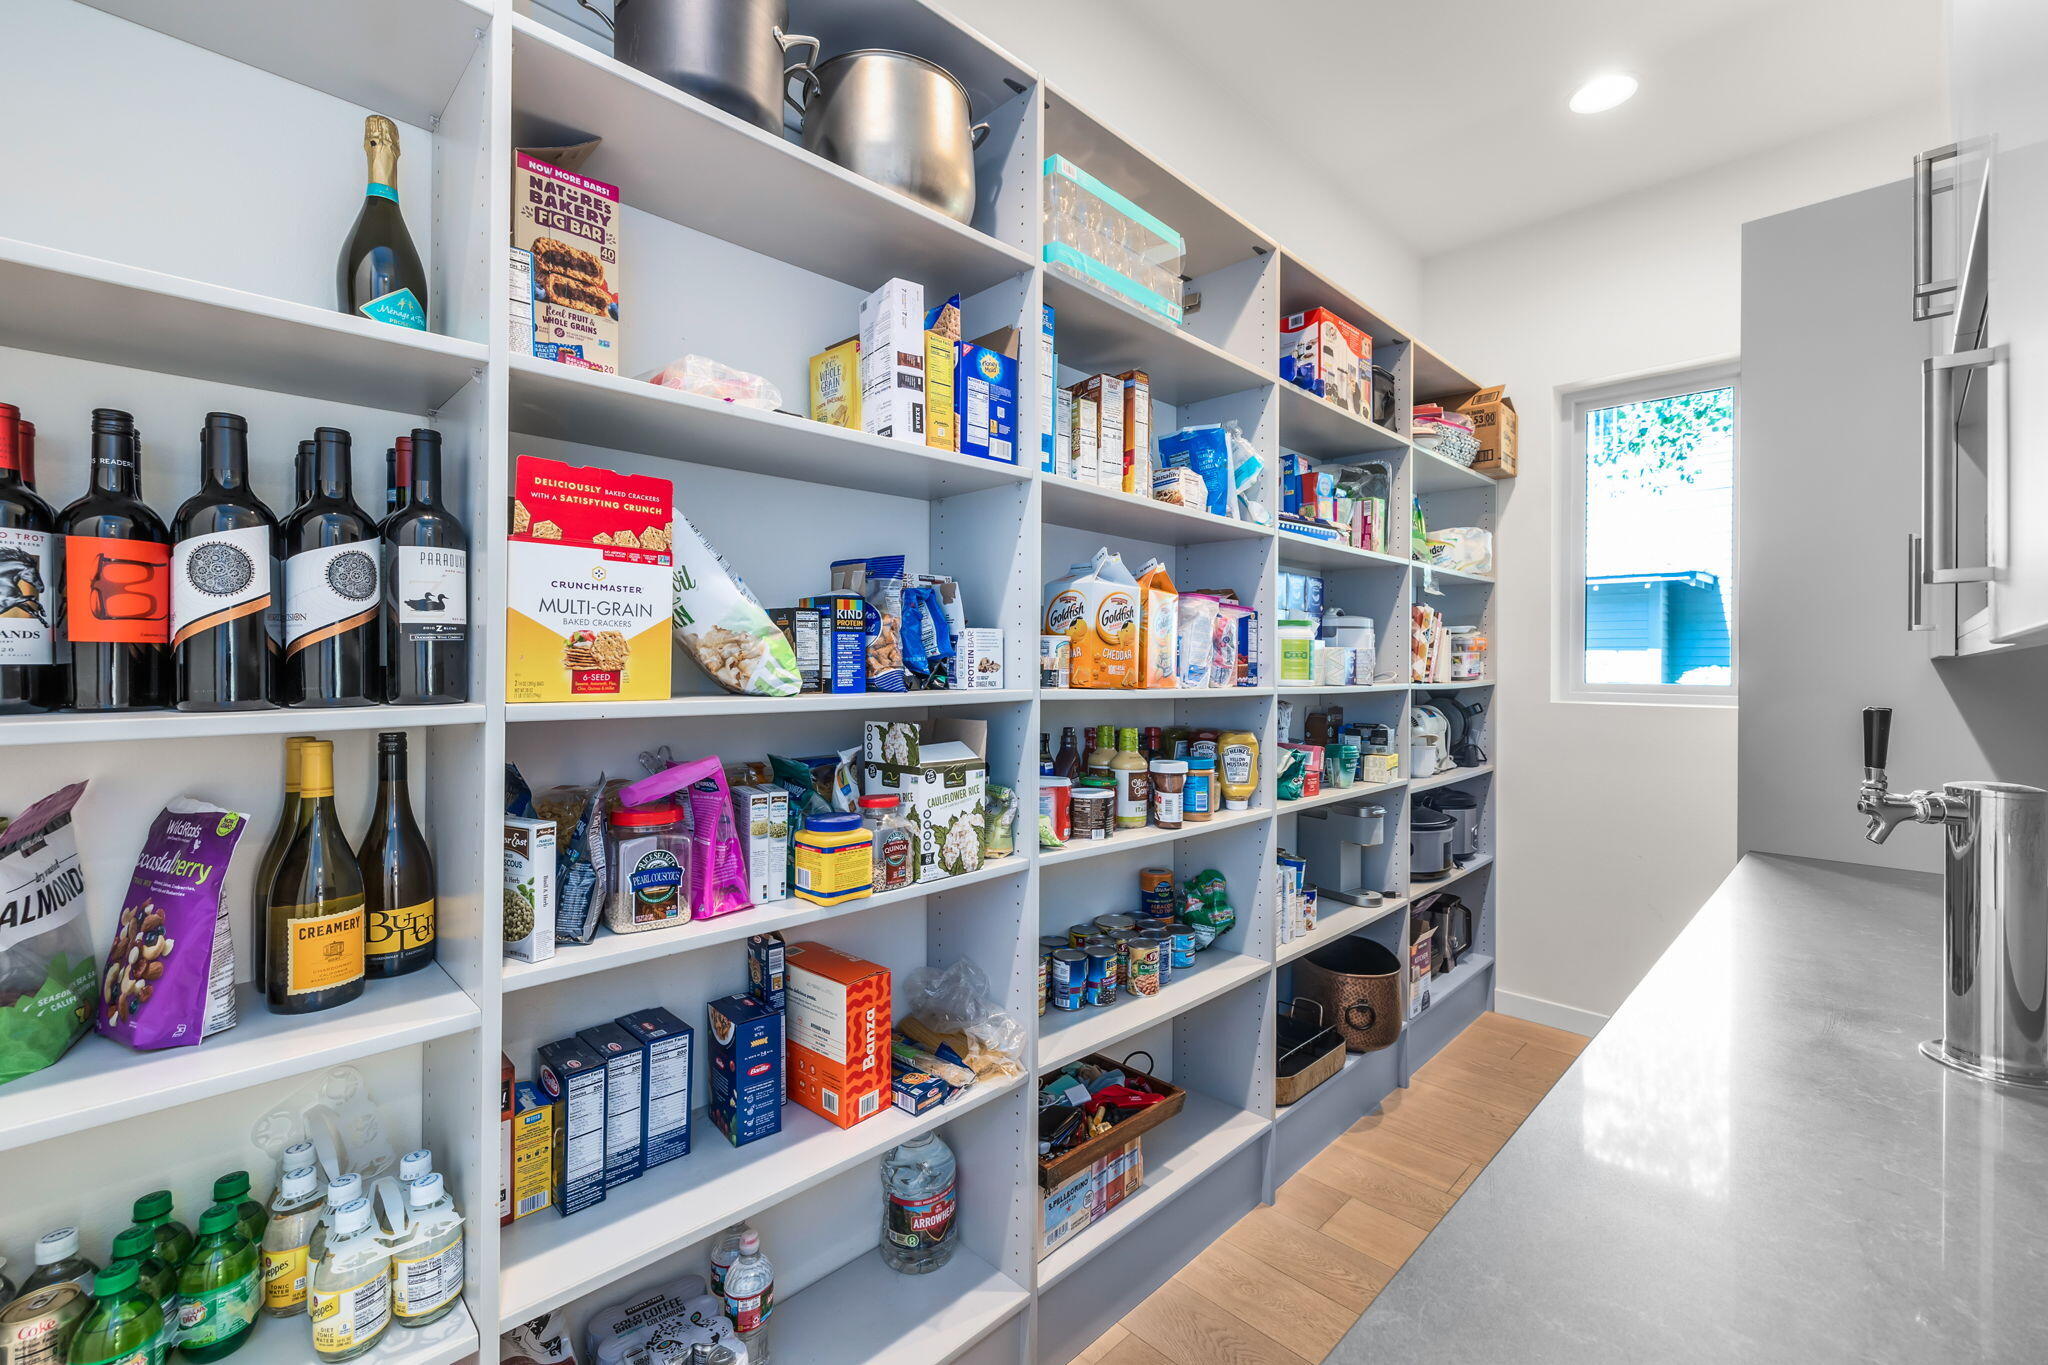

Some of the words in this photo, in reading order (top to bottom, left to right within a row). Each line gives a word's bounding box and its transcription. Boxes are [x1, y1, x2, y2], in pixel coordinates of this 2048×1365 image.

[529, 161, 552, 174] NOW
[555, 170, 581, 184] MORE
[584, 180, 610, 196] BARS!
[529, 189, 611, 227] BAKERY
[538, 210, 565, 229] FIG
[570, 219, 602, 242] BAR
[601, 248, 615, 261] 40
[546, 305, 566, 318] Real
[568, 313, 588, 324] FRUIT
[542, 316, 568, 328] WHOLE
[570, 322, 598, 335] GRAINS
[820, 365, 842, 382] WHOLE
[534, 476, 602, 494] DELICIOUSLY
[604, 489, 626, 498] BAKED
[628, 492, 660, 502] CRACKERS
[530, 492, 550, 500] WITH
[560, 494, 620, 509] SATISFYING
[624, 504, 662, 514] CRUNCH
[16, 534, 45, 542] TROT
[551, 580, 642, 594] CRUNCHMASTER
[538, 598, 653, 618] MULTI-GRAIN
[836, 610, 863, 620] KIND
[1050, 602, 1086, 626] Goldfish
[1102, 605, 1134, 626] Goldfish
[562, 618, 590, 626] BAKED
[592, 619, 632, 628] CRACKERS
[0, 630, 40, 639] ANDS
[1103, 648, 1132, 660] CHEDDAR
[902, 792, 913, 802] RICE
[927, 788, 967, 808] CAULIFLOWER
[968, 785, 980, 796] RICE
[512, 832, 528, 848] East
[884, 845, 908, 854] QUINOA
[504, 860, 522, 868] SCOUS
[508, 876, 520, 884] Herb
[633, 874, 651, 886] PEARL
[298, 916, 361, 940] CREAMERY
[863, 1008, 876, 1071] Banza
[644, 1296, 685, 1320] COFFEE
[646, 1306, 686, 1326] COLOMBIAN
[18, 1319, 56, 1340] Coke
[613, 1315, 640, 1329] COLD
[614, 1318, 642, 1334] BREW
